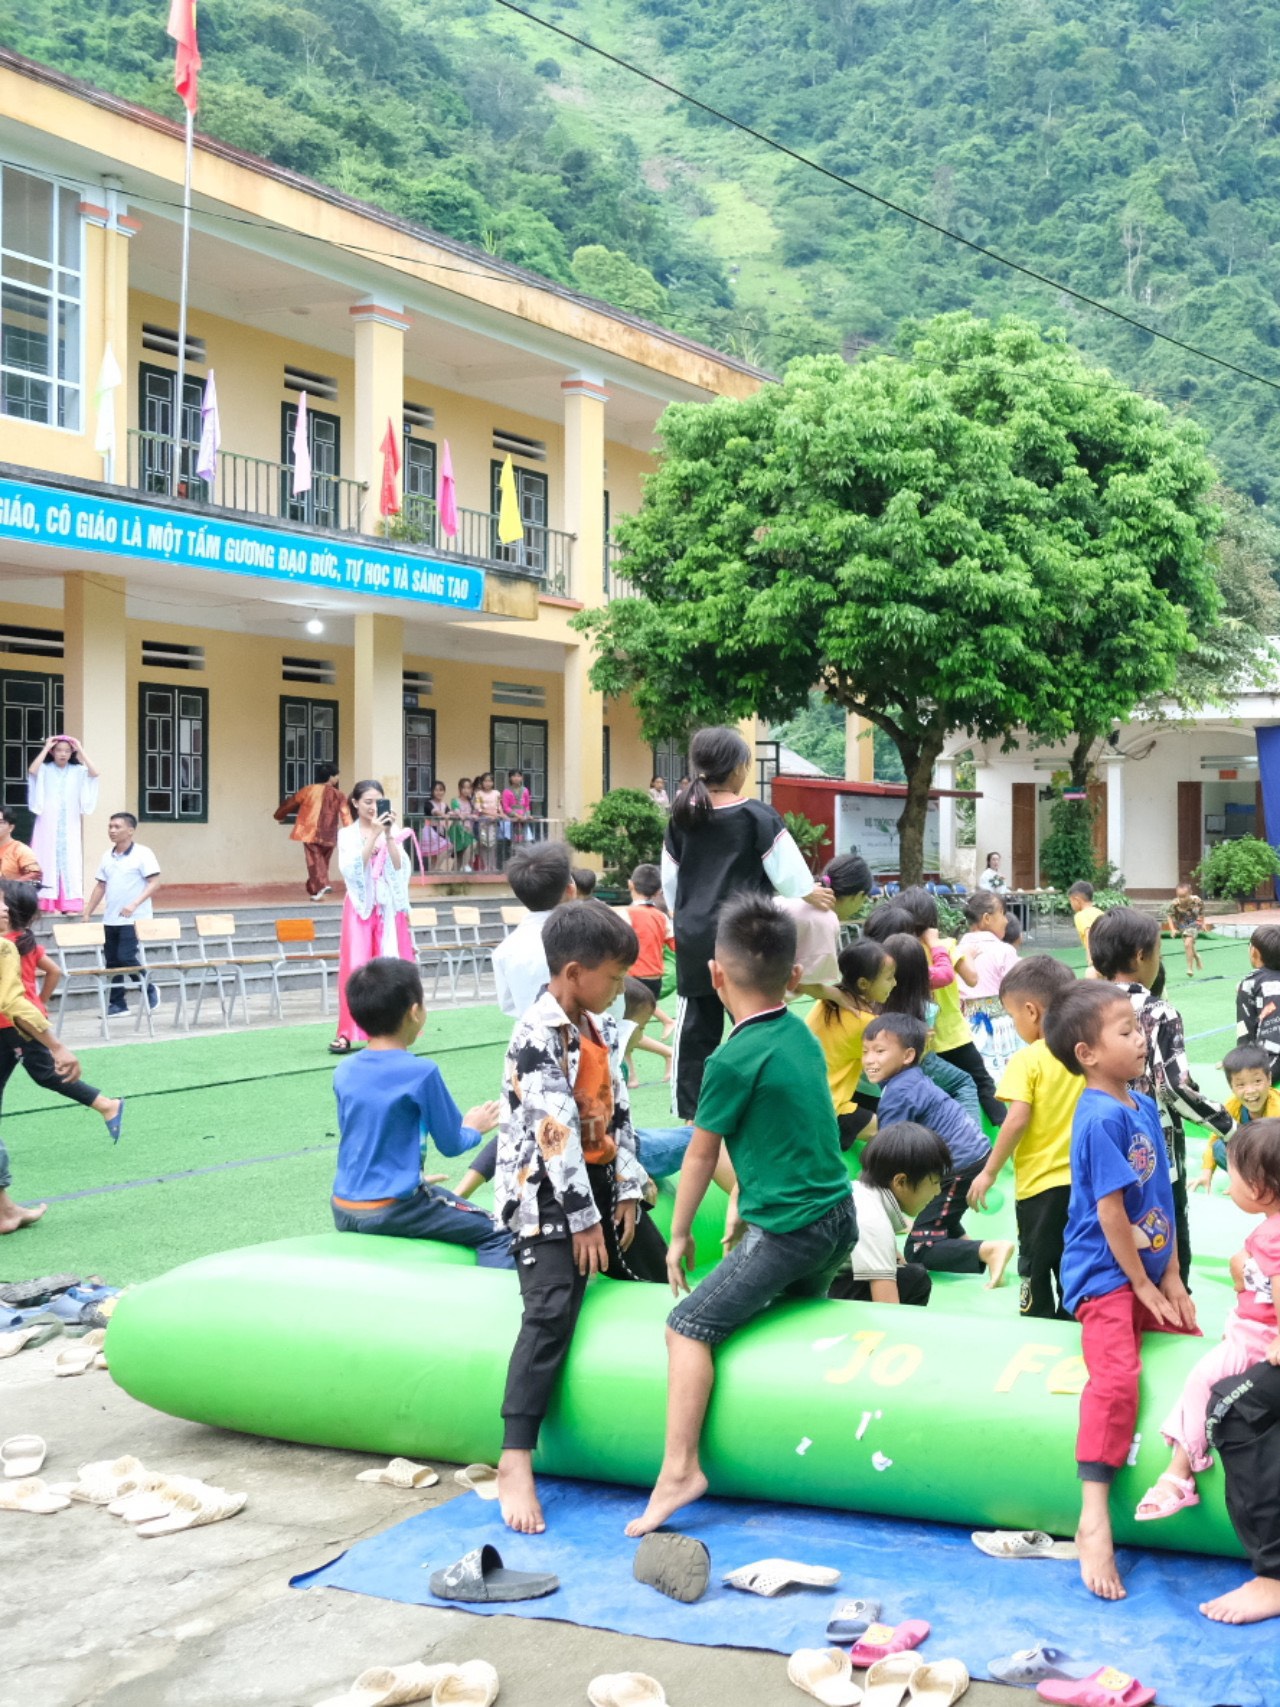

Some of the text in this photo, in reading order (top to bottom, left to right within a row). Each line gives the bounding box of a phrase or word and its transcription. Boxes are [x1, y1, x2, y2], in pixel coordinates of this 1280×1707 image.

[46, 503, 71, 536] CÔ
[76, 510, 118, 543] GIÁO
[121, 516, 142, 548] LÀ
[147, 522, 183, 558] MỘT
[187, 525, 222, 561] TẤM
[225, 537, 275, 569] GƯƠNG
[278, 547, 307, 577] ĐẠO
[310, 548, 341, 582] ĐỨC,
[345, 558, 363, 587] TỰ
[364, 562, 390, 590] HỌC
[393, 563, 409, 591] VÀ
[412, 567, 444, 596] SÁNG
[447, 576, 470, 603] TẠO
